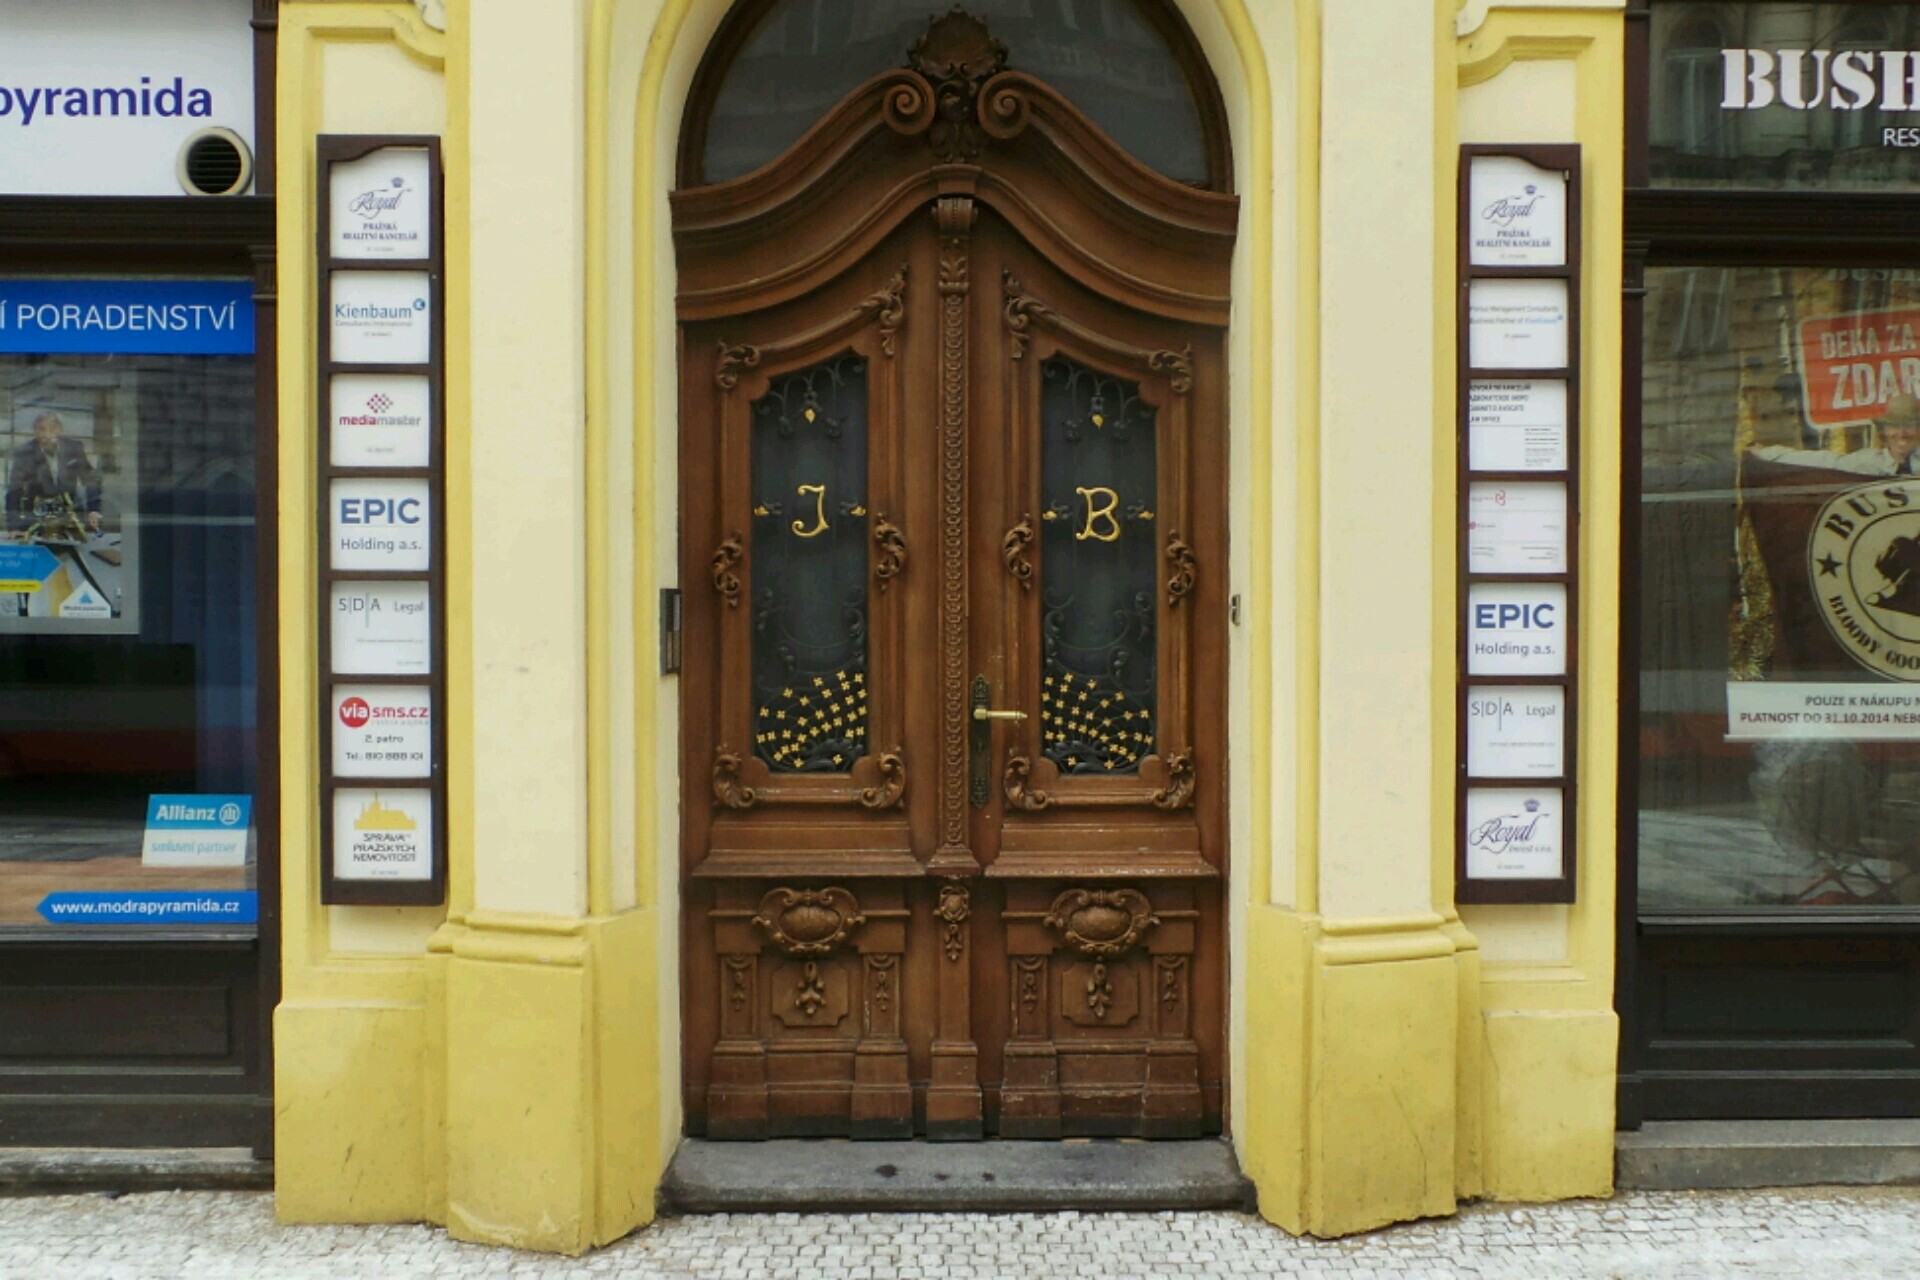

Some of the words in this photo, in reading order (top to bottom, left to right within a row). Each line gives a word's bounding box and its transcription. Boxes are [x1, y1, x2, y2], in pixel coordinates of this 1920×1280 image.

[1481, 195, 1545, 227] Royal
[17, 300, 236, 330] PORADENSTVÍ
[335, 303, 412, 319] Kienbaum
[1821, 327, 1881, 360] DEKA
[1886, 323, 1917, 353] ZA
[1830, 357, 1920, 410] ZDAR
[338, 414, 421, 427] mediamaster
[340, 498, 420, 524] EPIC
[1075, 486, 1121, 542] B
[341, 538, 395, 554] Holding
[398, 541, 422, 551] a.s.
[394, 601, 424, 615] Legal
[1475, 603, 1555, 629] EPIC
[1829, 595, 1882, 655] BLOODY
[1475, 642, 1529, 657] Holding
[1533, 645, 1556, 655] a.s.
[1805, 695, 1845, 706] POUZE
[1848, 696, 1858, 706] K
[1860, 693, 1912, 706] NÁKUPU
[1526, 705, 1556, 717] Legal
[1740, 712, 1800, 723] PLATNOST
[1803, 712, 1822, 723] DO
[1825, 712, 1889, 723] 31.10.2014
[376, 734, 404, 744] patro
[155, 804, 217, 821] Allianz
[1470, 813, 1549, 855] Royal
[51, 899, 240, 916] www.modrapyramida.cz
